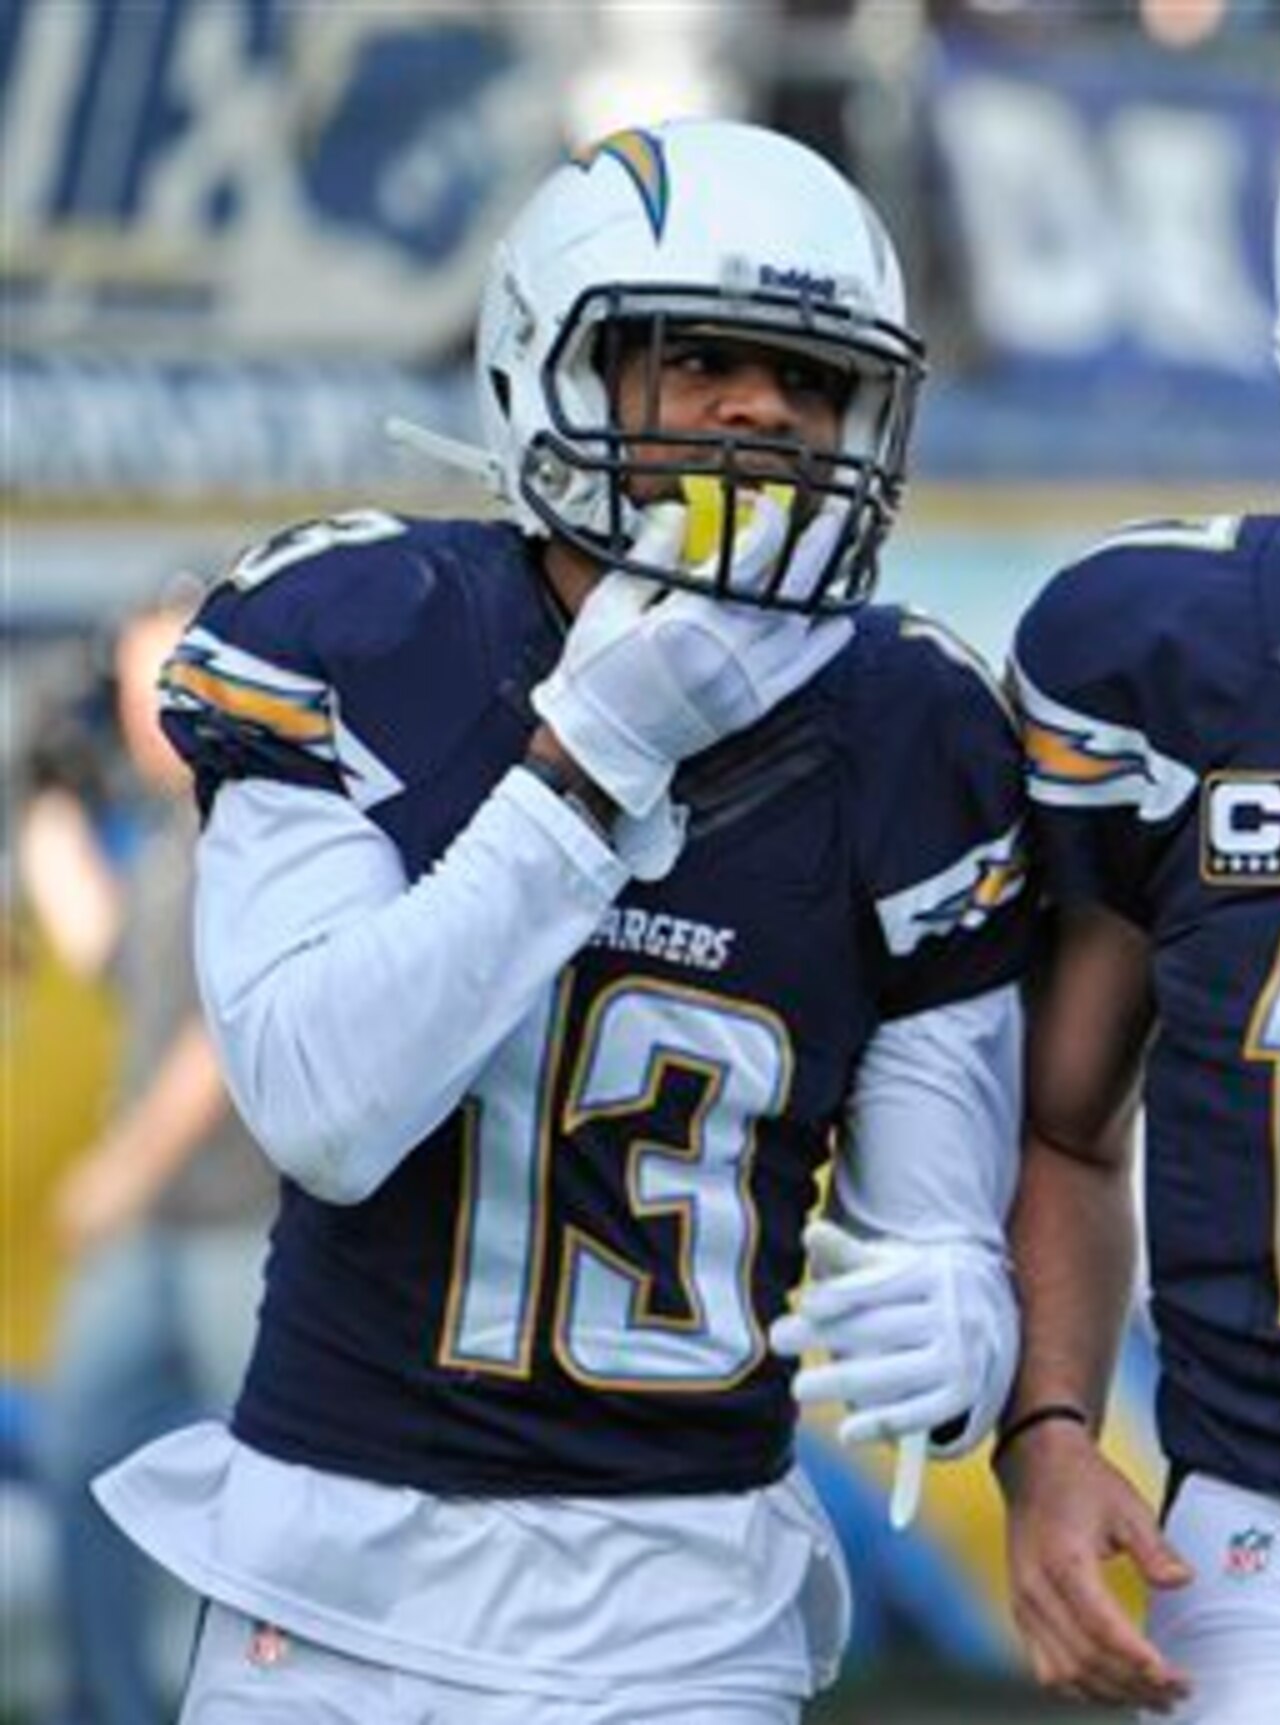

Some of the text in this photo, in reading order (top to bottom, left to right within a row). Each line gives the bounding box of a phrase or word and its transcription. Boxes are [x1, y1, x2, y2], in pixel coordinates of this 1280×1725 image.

[759, 264, 836, 299] Riddell
[592, 905, 737, 971] ARGERS
[439, 964, 796, 1391] 13
